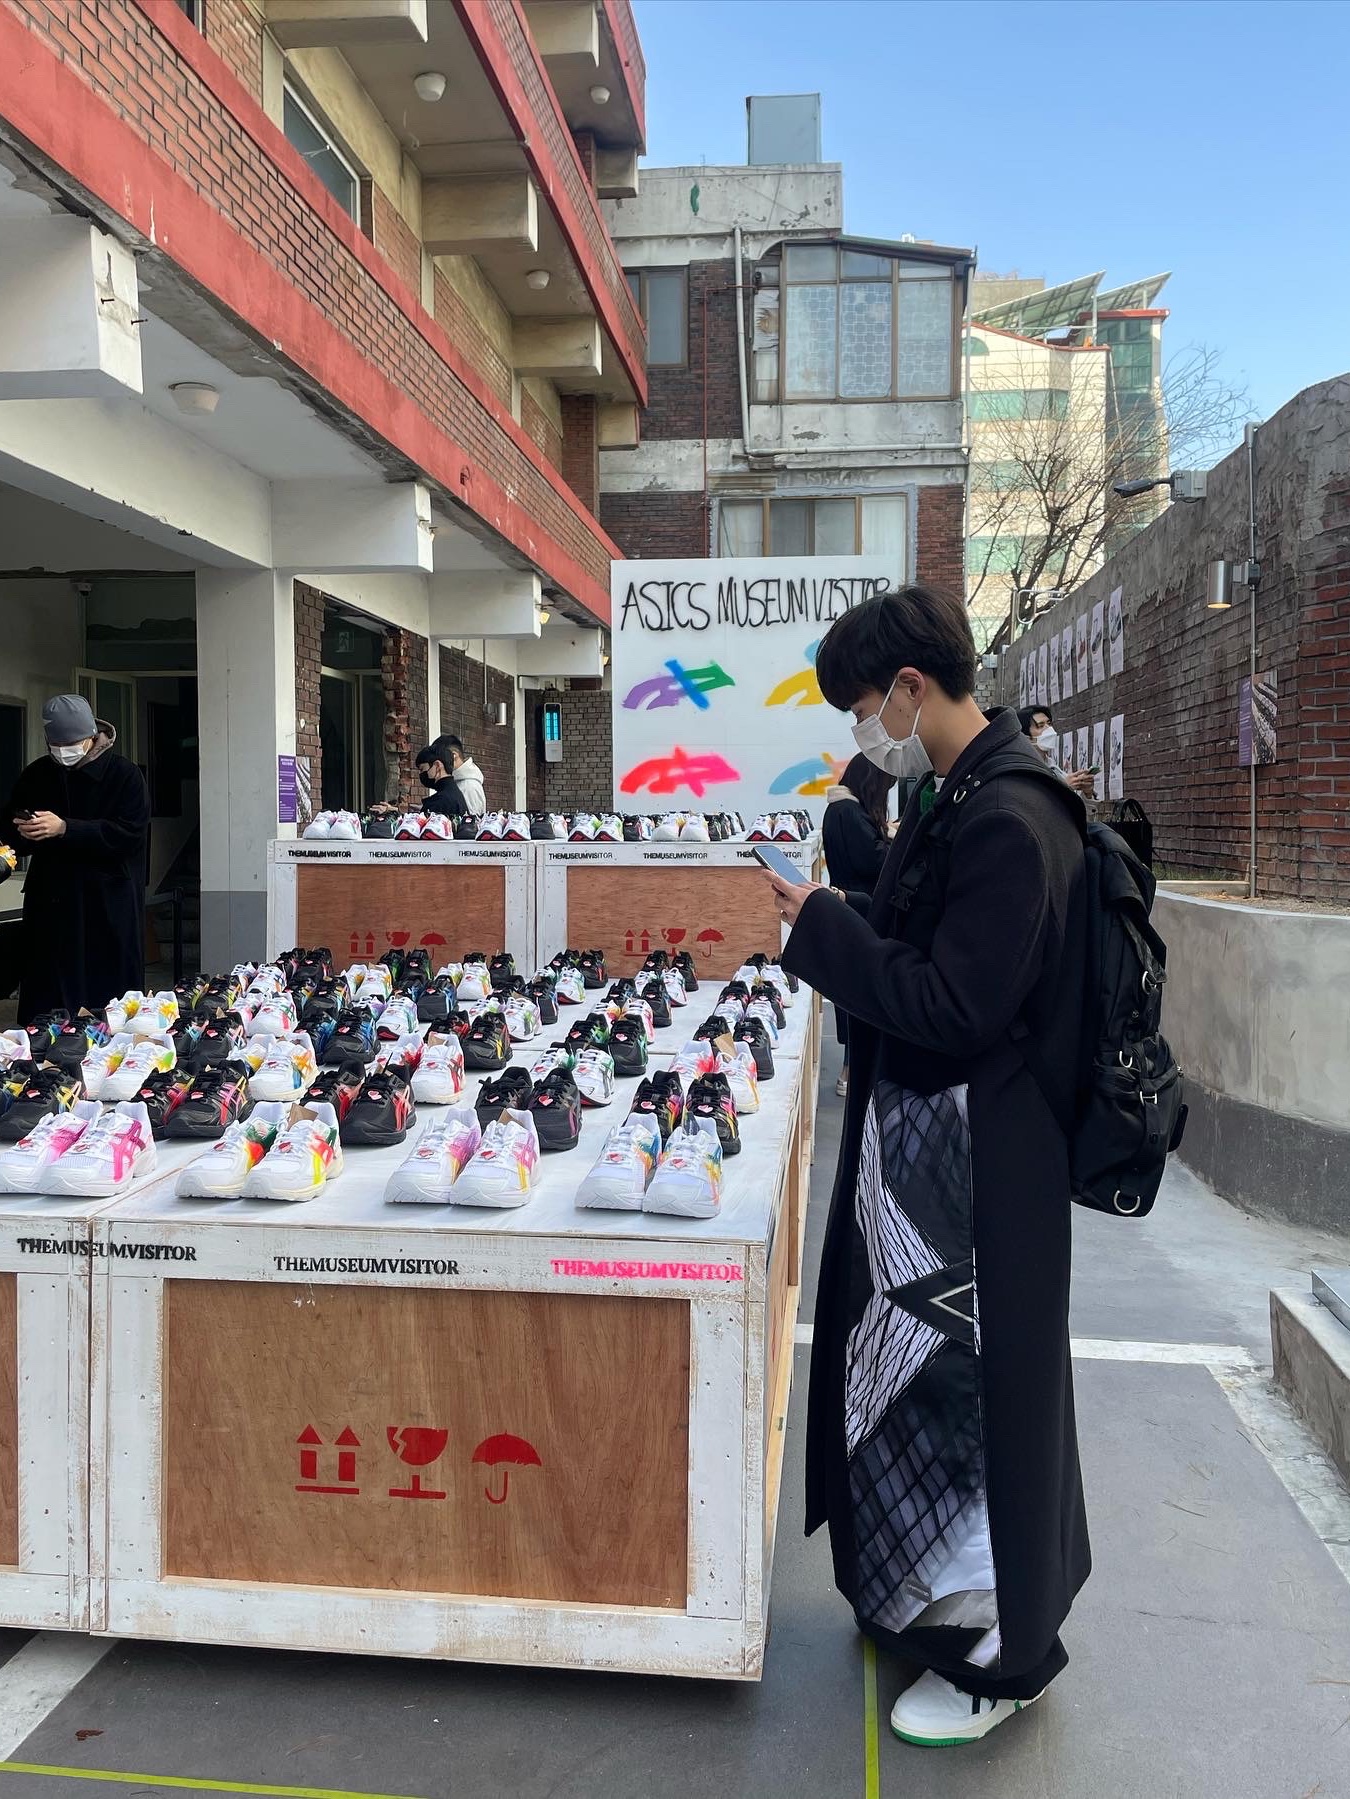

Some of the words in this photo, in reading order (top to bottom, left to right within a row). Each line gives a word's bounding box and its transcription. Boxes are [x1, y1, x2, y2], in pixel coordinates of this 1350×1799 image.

[621, 581, 710, 631] ASICS
[17, 1237, 197, 1261] THEMUSEUMVISITOR
[273, 1256, 459, 1275] THEMUSEUMVISITOR
[551, 1259, 743, 1280] THEMUSEUMVISITOR
